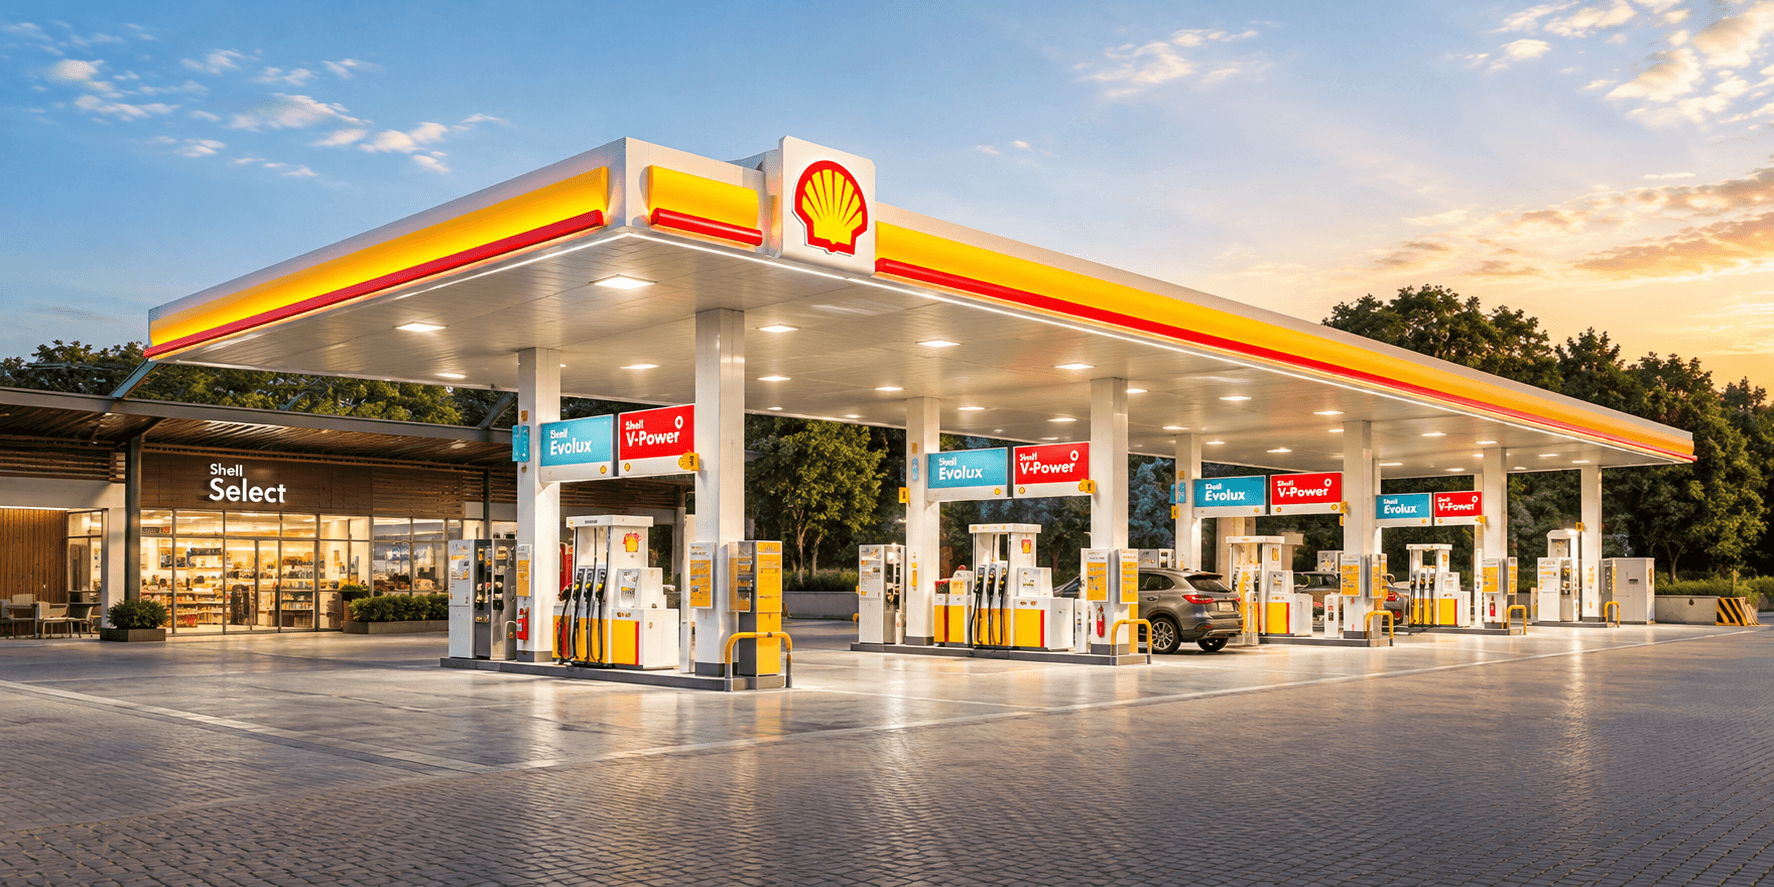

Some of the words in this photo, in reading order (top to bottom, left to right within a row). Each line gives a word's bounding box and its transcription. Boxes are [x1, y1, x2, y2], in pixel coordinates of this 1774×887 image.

[626, 430, 680, 447] V-Power
[550, 437, 592, 456] Evolux
[210, 463, 243, 477] Shell
[938, 465, 983, 481] Evolux
[1019, 461, 1076, 475] V-Power
[209, 477, 287, 503] Select
[1205, 489, 1246, 501] Evolux
[1277, 486, 1329, 498] V-Power
[1384, 503, 1417, 514] Evolux
